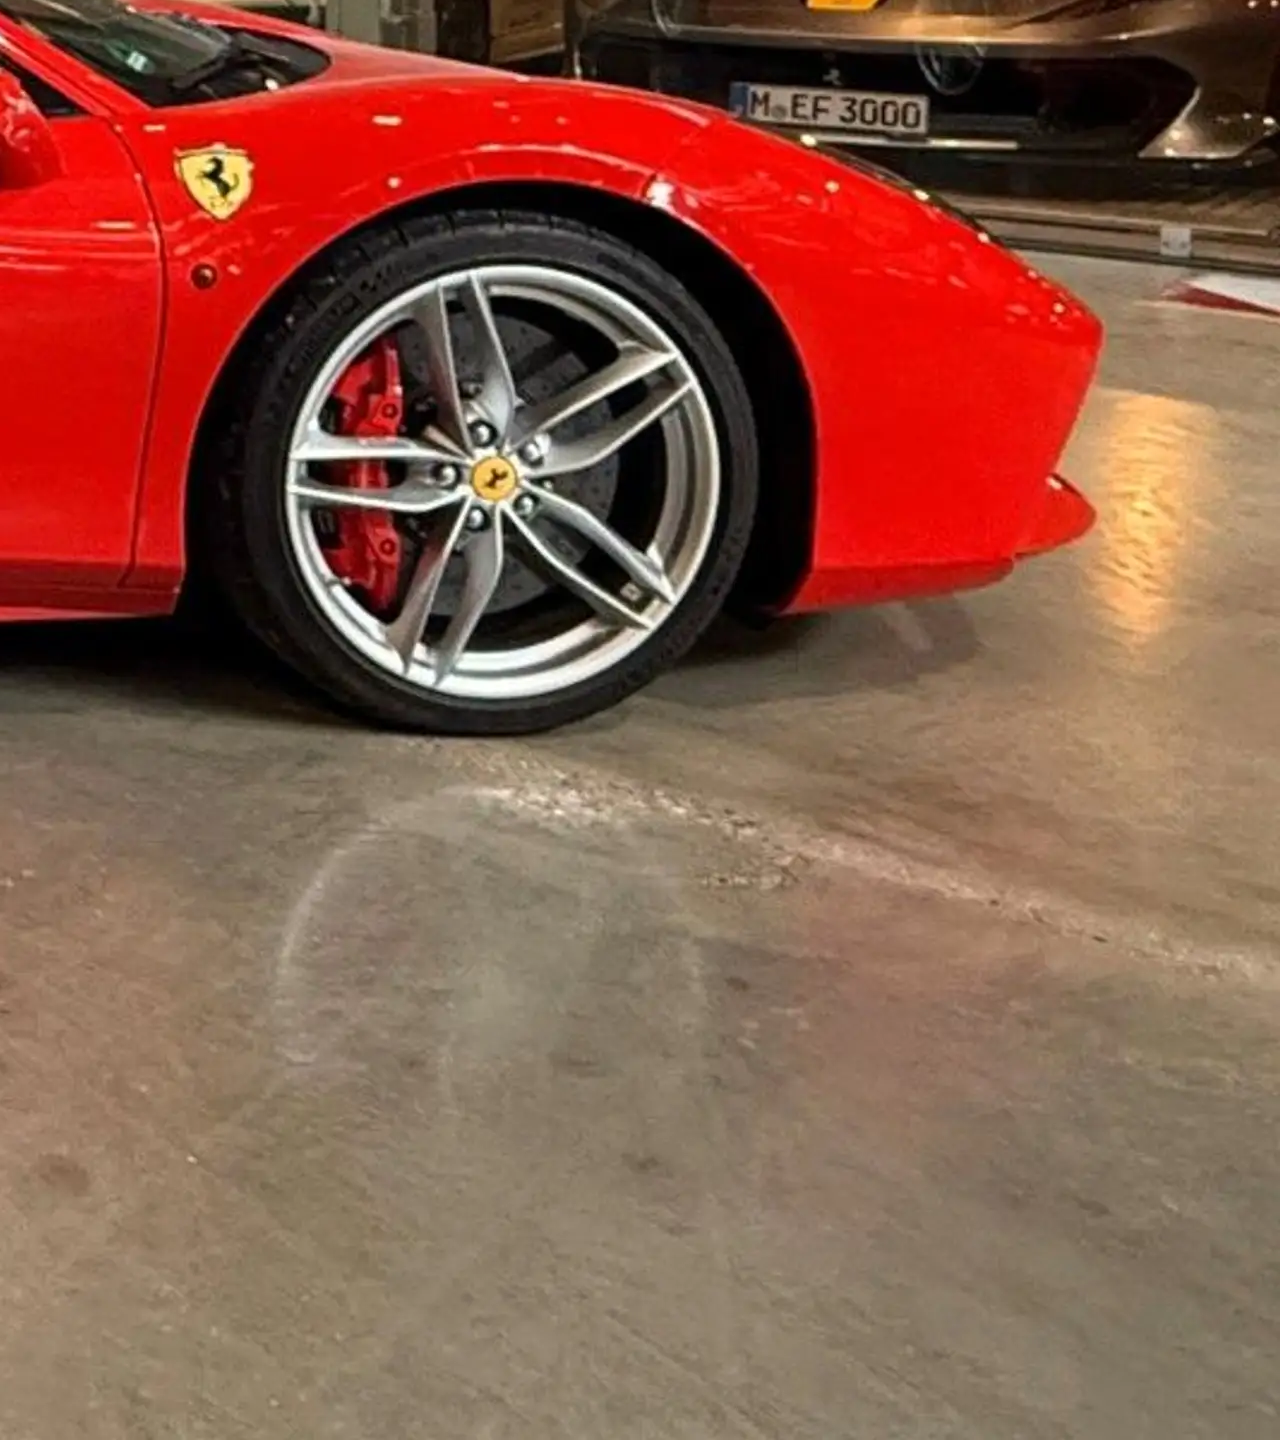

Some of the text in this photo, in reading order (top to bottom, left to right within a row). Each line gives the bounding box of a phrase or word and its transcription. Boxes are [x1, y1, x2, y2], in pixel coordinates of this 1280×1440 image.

[749, 90, 922, 129] M EF 3000
